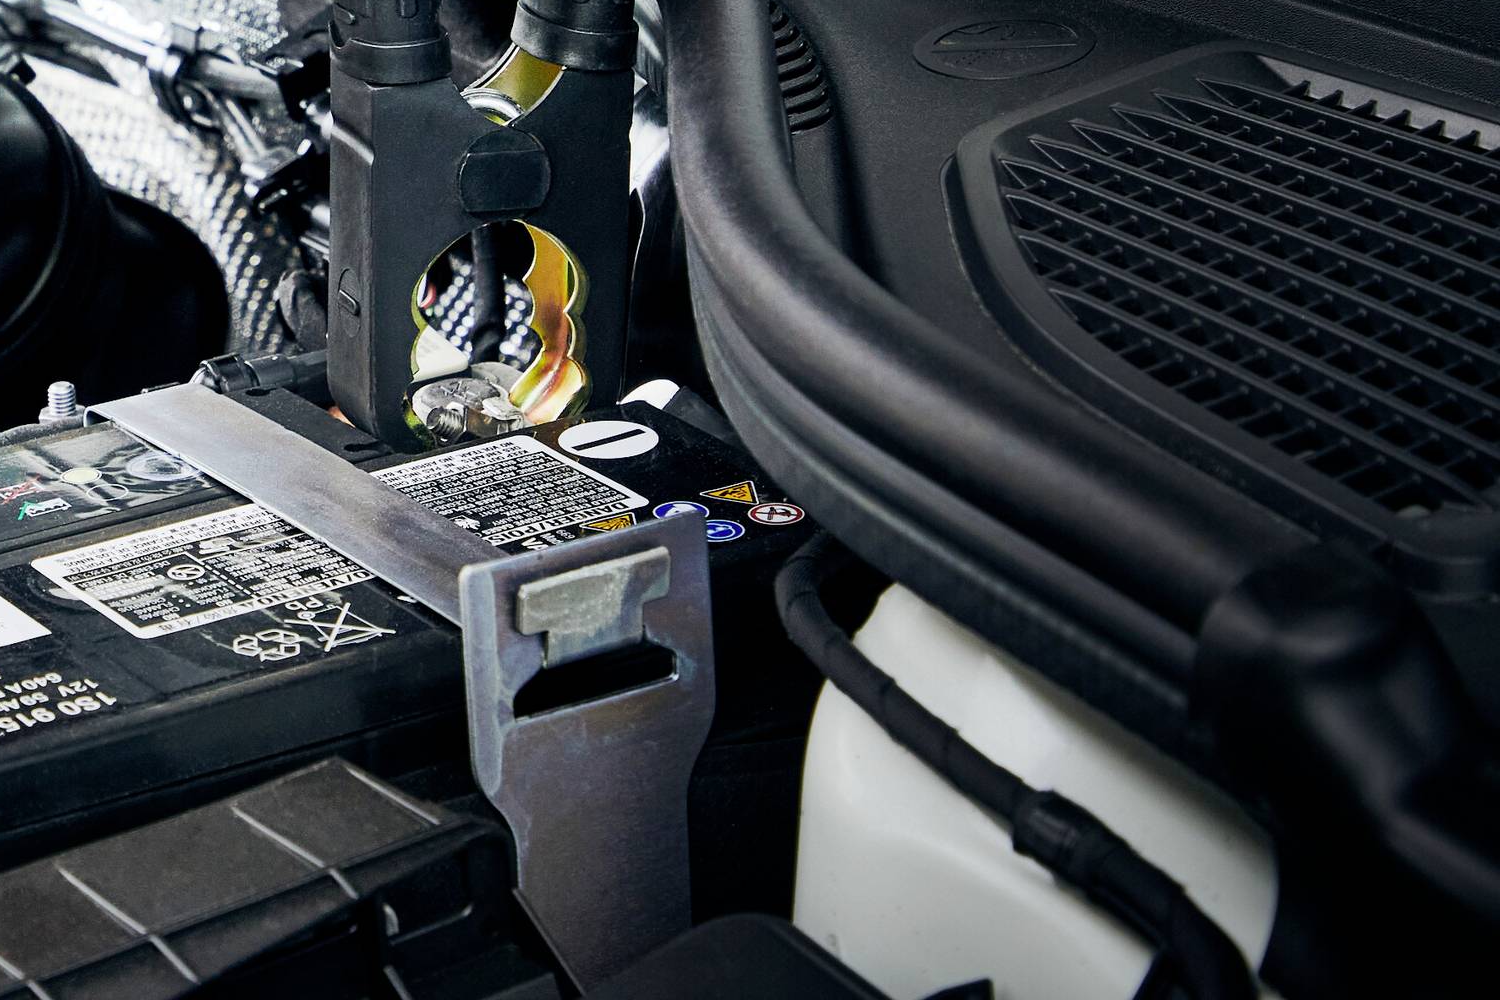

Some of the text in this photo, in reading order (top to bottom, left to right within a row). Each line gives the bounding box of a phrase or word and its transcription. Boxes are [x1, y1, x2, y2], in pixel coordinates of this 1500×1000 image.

[485, 502, 628, 543] DANGER/POIS
[285, 596, 323, 610] Pb
[4, 672, 61, 693] 640A
[58, 678, 98, 696] 12V
[57, 692, 116, 715] 1S0
